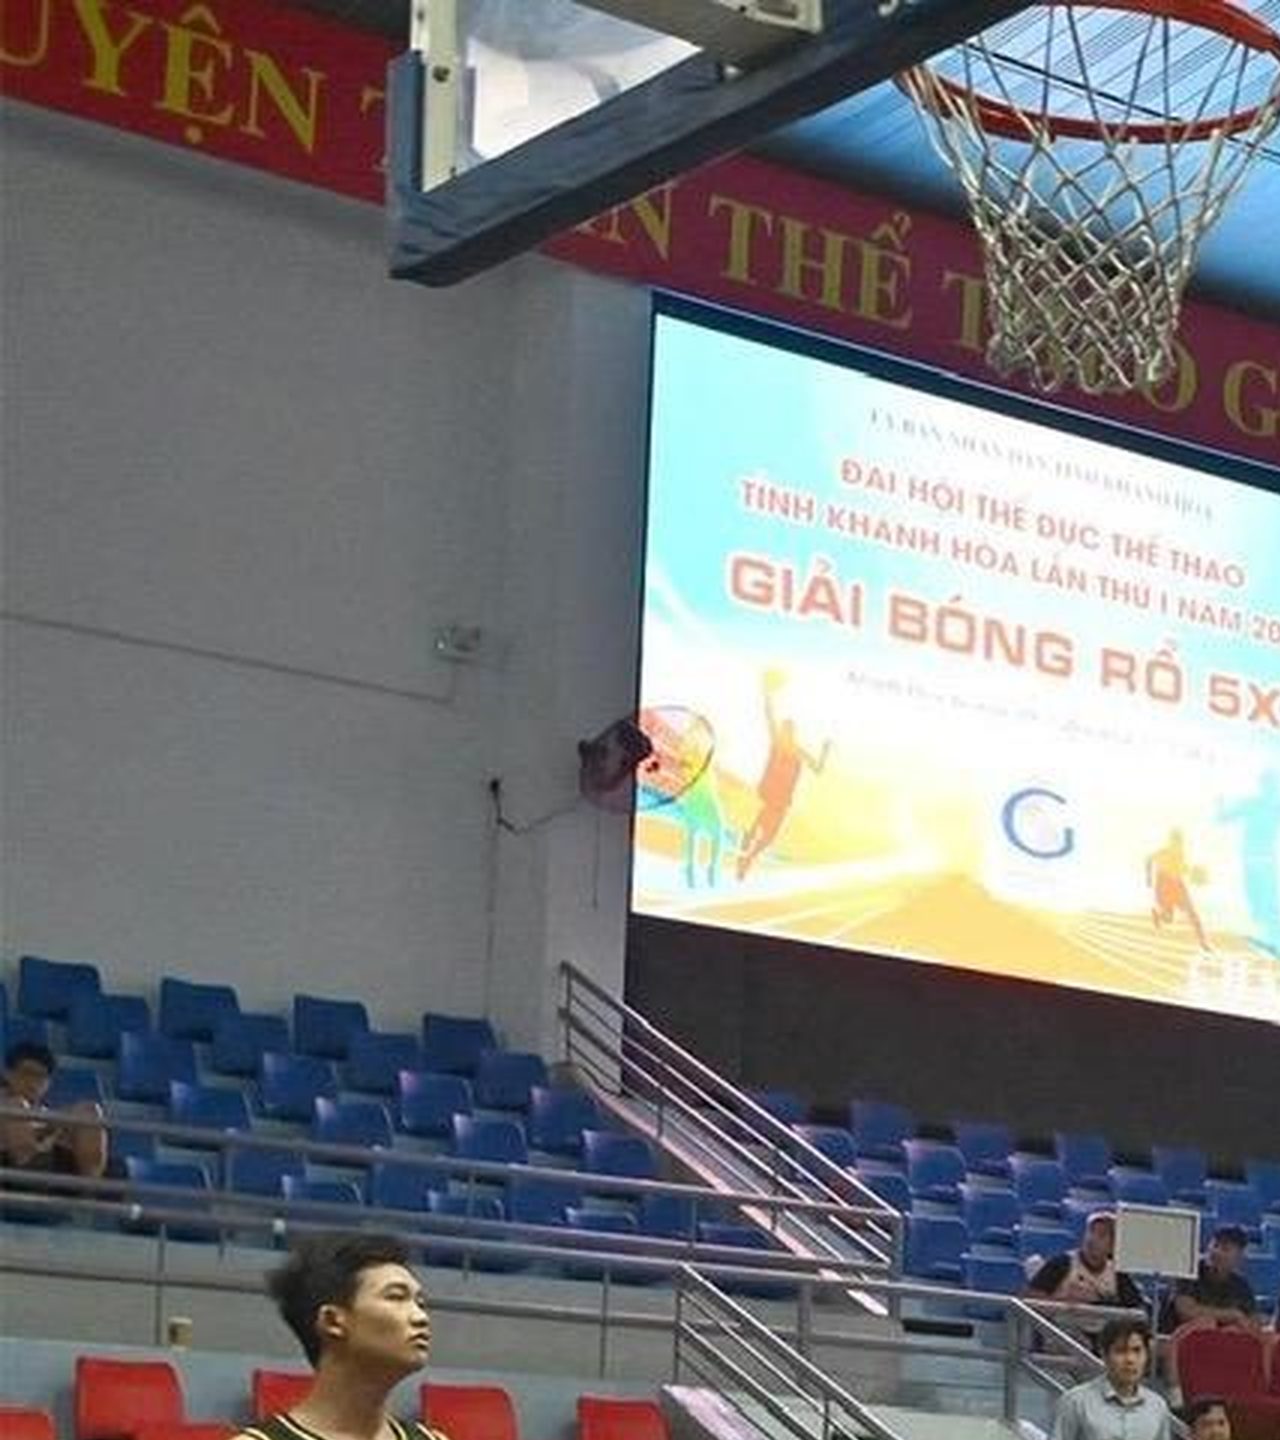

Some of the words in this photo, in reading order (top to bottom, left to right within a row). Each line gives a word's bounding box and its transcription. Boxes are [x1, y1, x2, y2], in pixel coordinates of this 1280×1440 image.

[708, 193, 914, 330] THỂ
[731, 556, 861, 628] GIẢI
[889, 594, 1074, 679] BÓNG
[1101, 637, 1182, 704] RỔ
[1170, 549, 1247, 589] THAO
